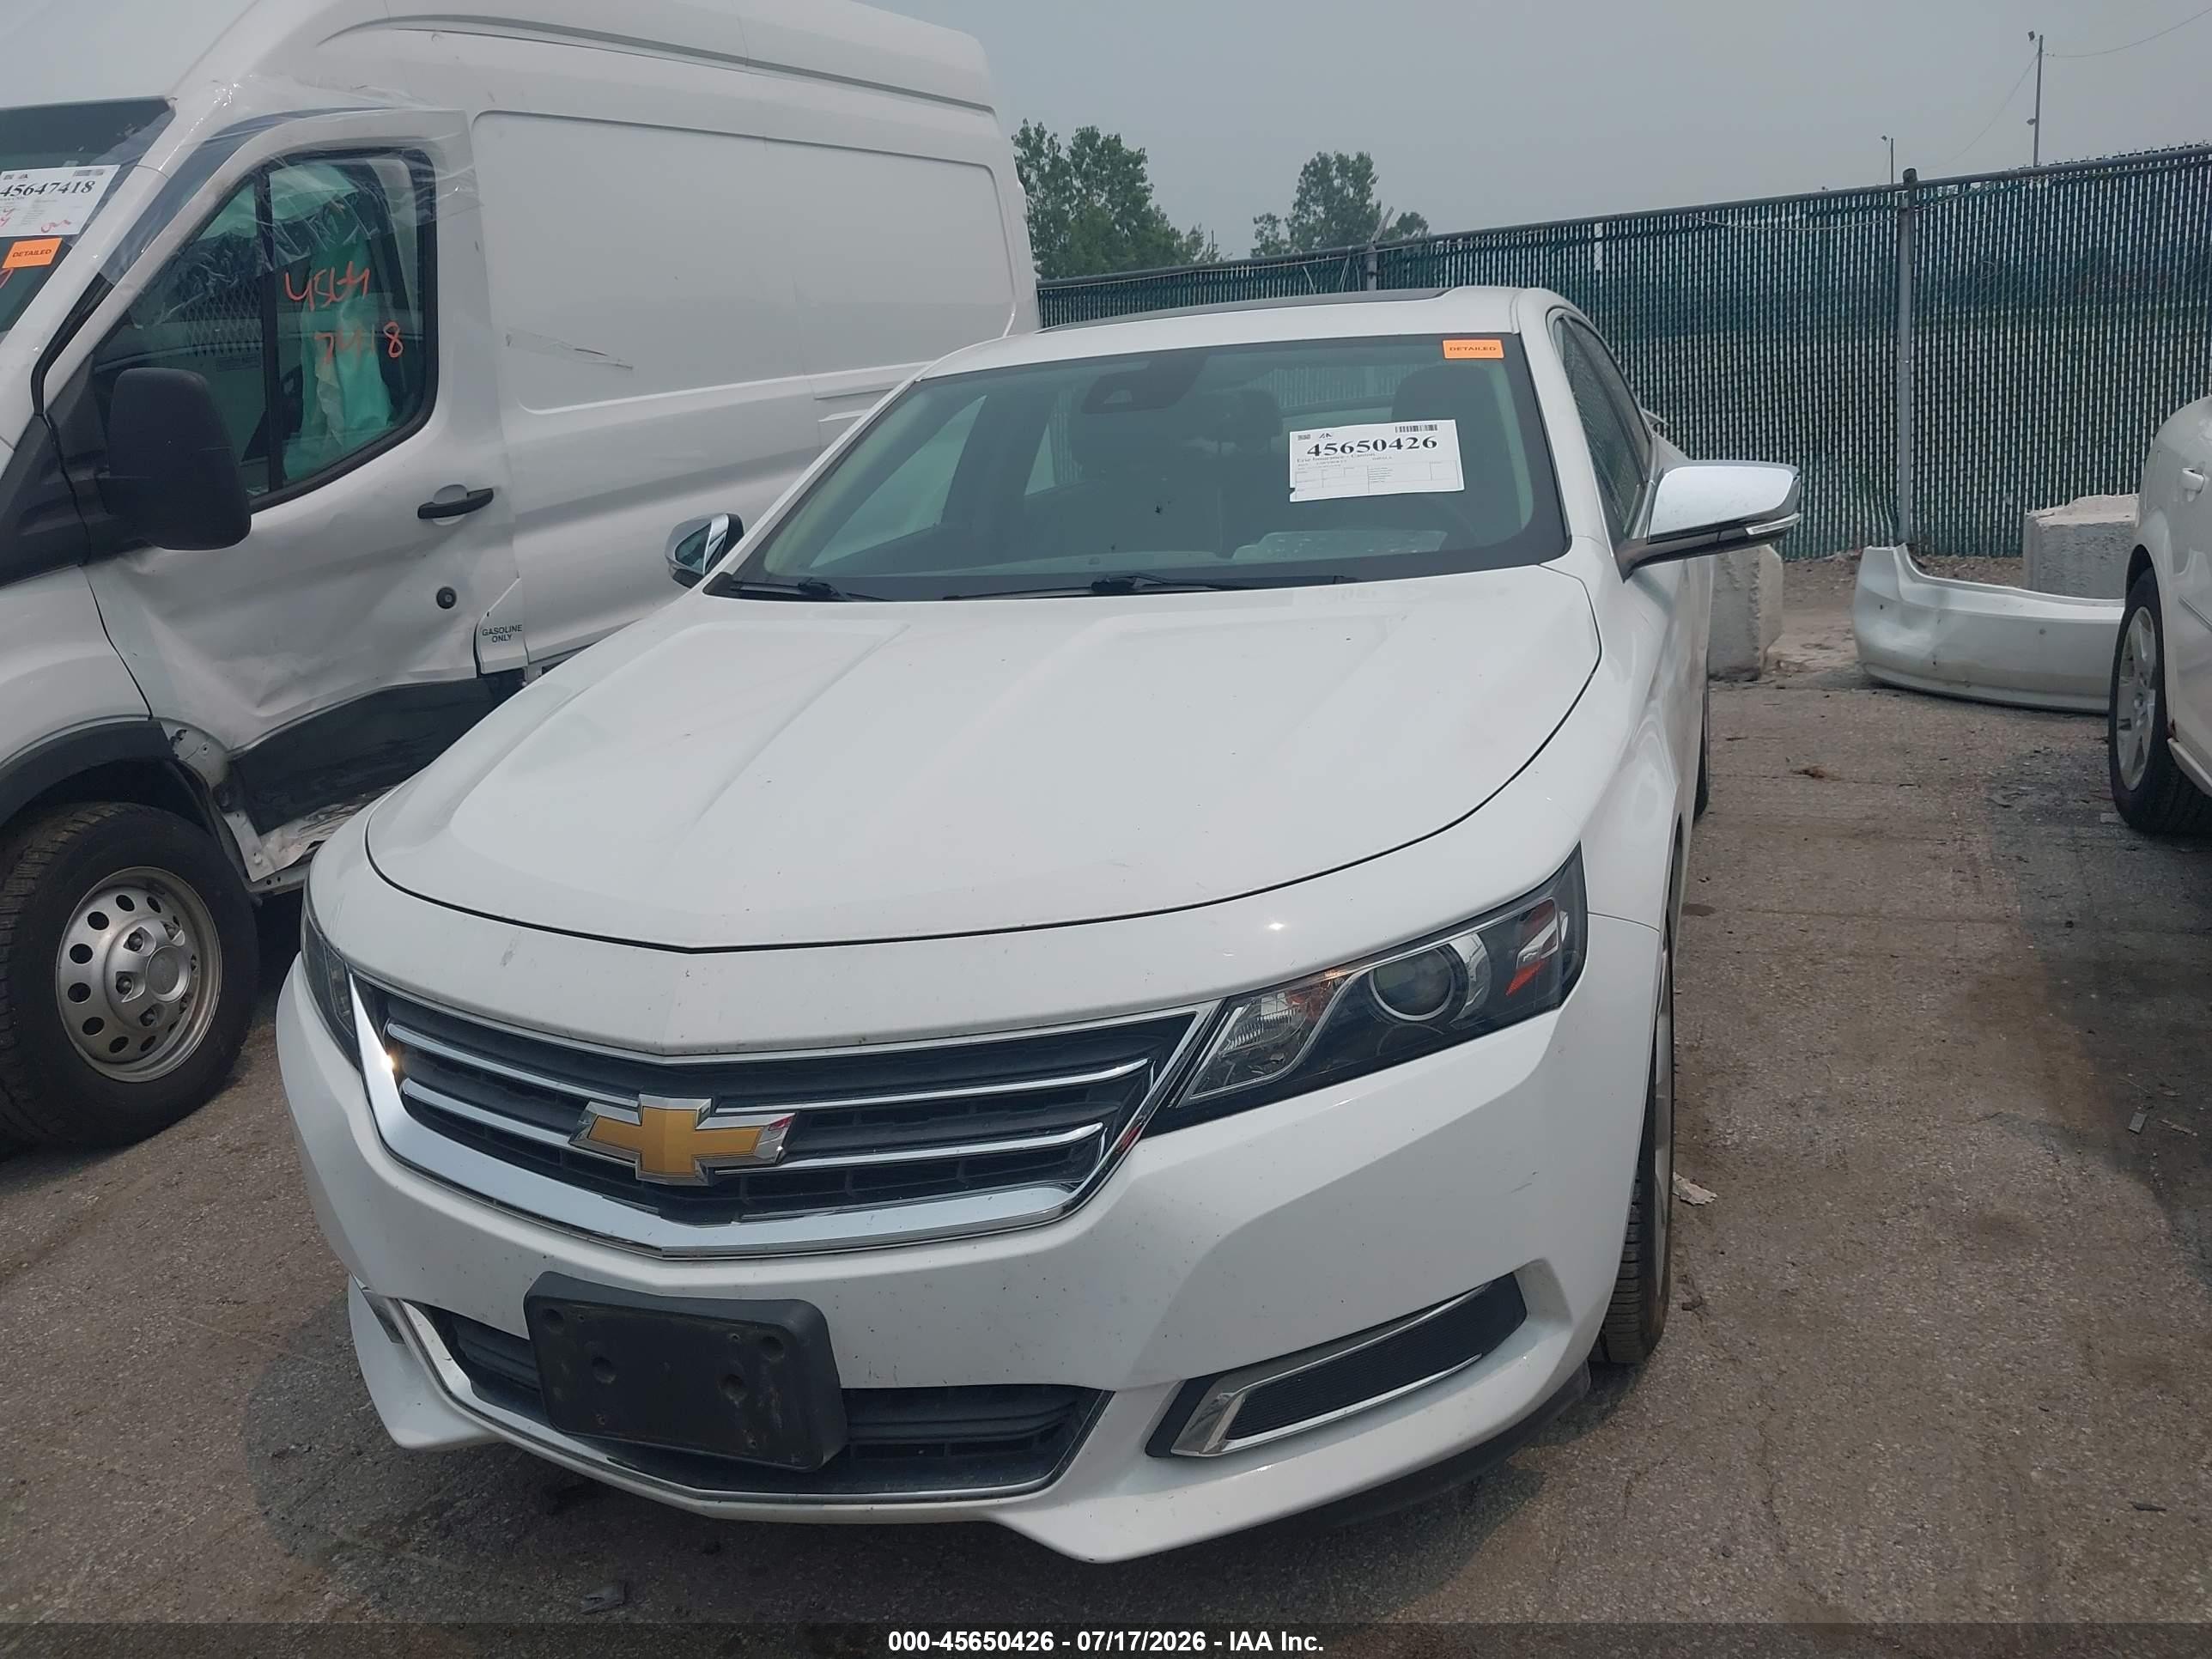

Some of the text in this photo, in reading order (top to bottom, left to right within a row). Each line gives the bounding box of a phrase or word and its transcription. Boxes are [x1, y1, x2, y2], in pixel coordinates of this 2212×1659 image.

[0, 180, 96, 198] 45647418
[12, 249, 52, 258] DETAILED
[1307, 435, 1437, 457] 45650426
[482, 624, 522, 636] GASOLINE
[492, 634, 513, 643] ONLY
